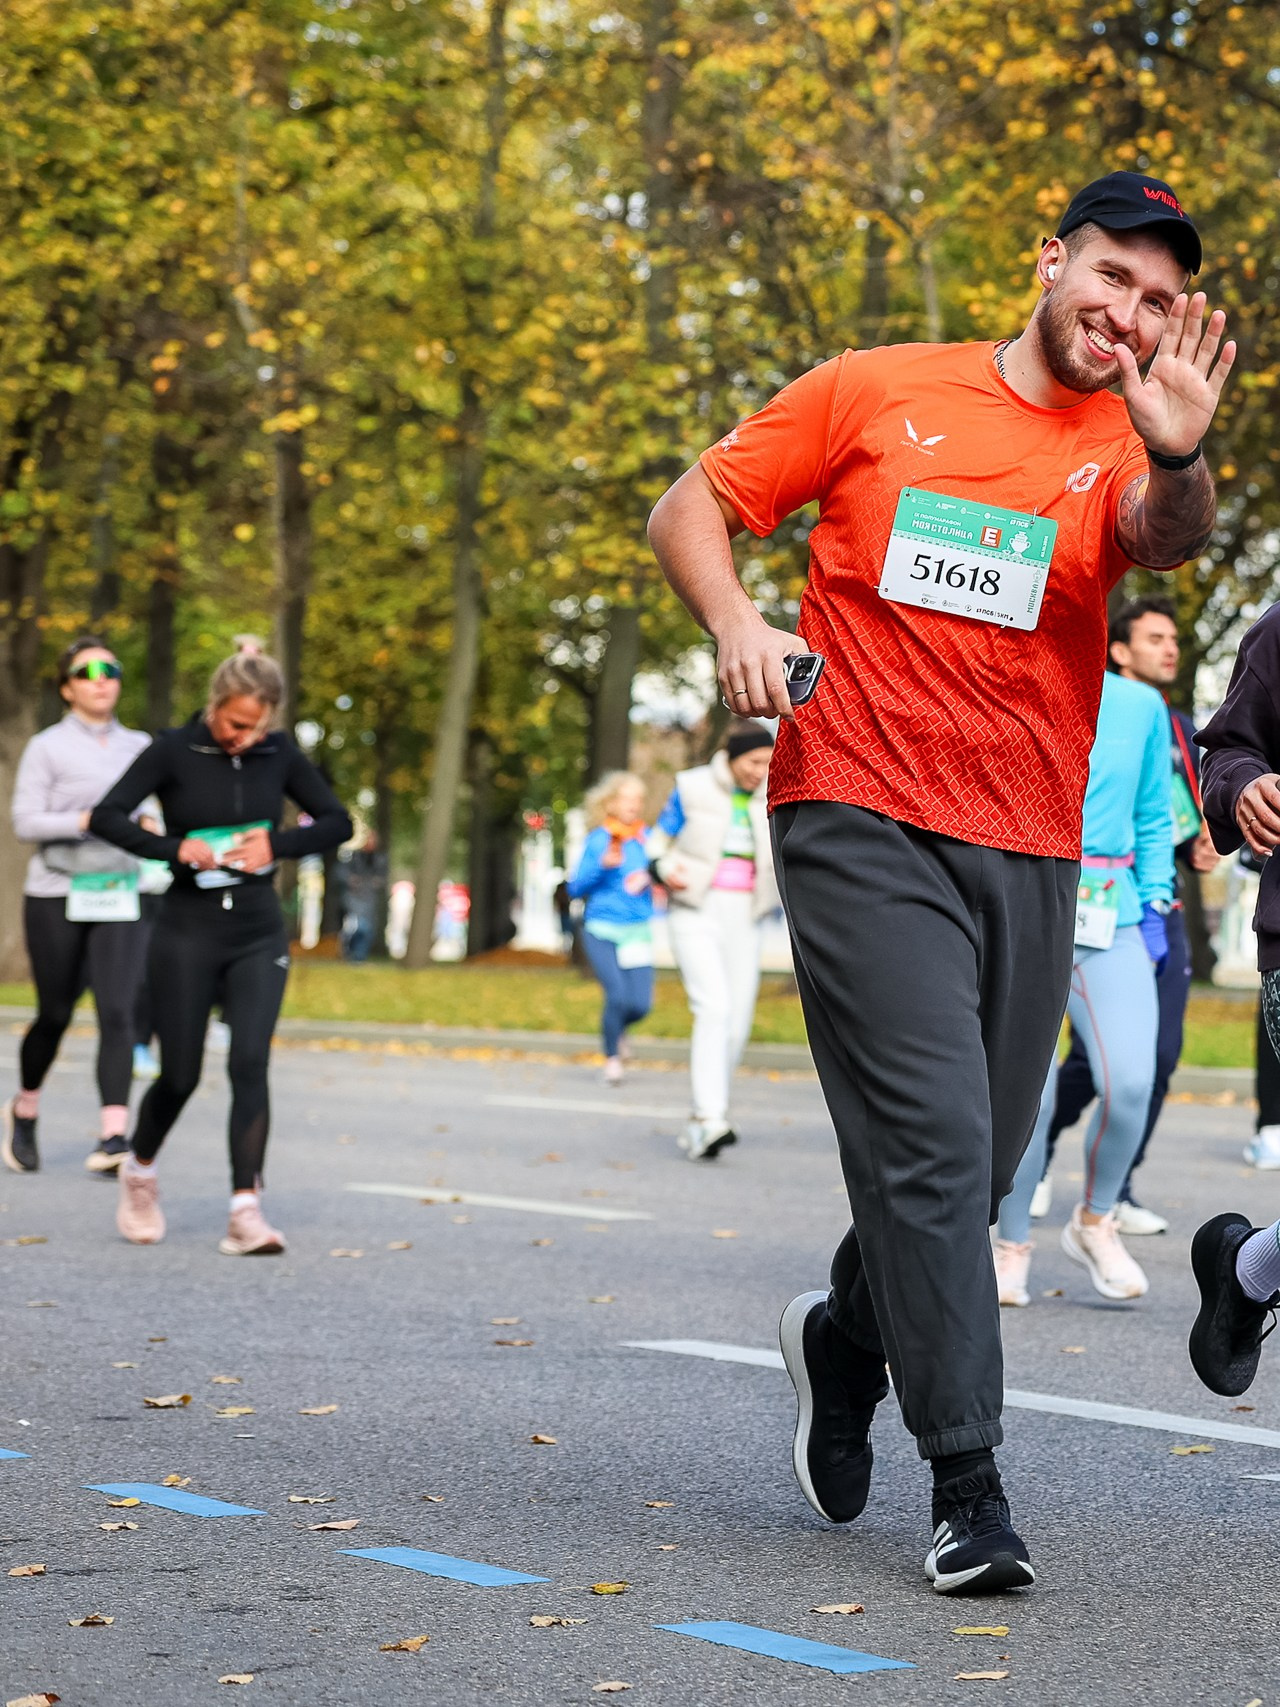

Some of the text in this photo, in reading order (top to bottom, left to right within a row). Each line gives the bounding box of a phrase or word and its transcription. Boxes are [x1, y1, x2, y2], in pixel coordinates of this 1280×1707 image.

[911, 519, 974, 540] МОЯ СТОЛИЦА
[983, 527, 999, 544] E
[909, 553, 1001, 596] 51618
[1026, 583, 1039, 614] МОСКВА
